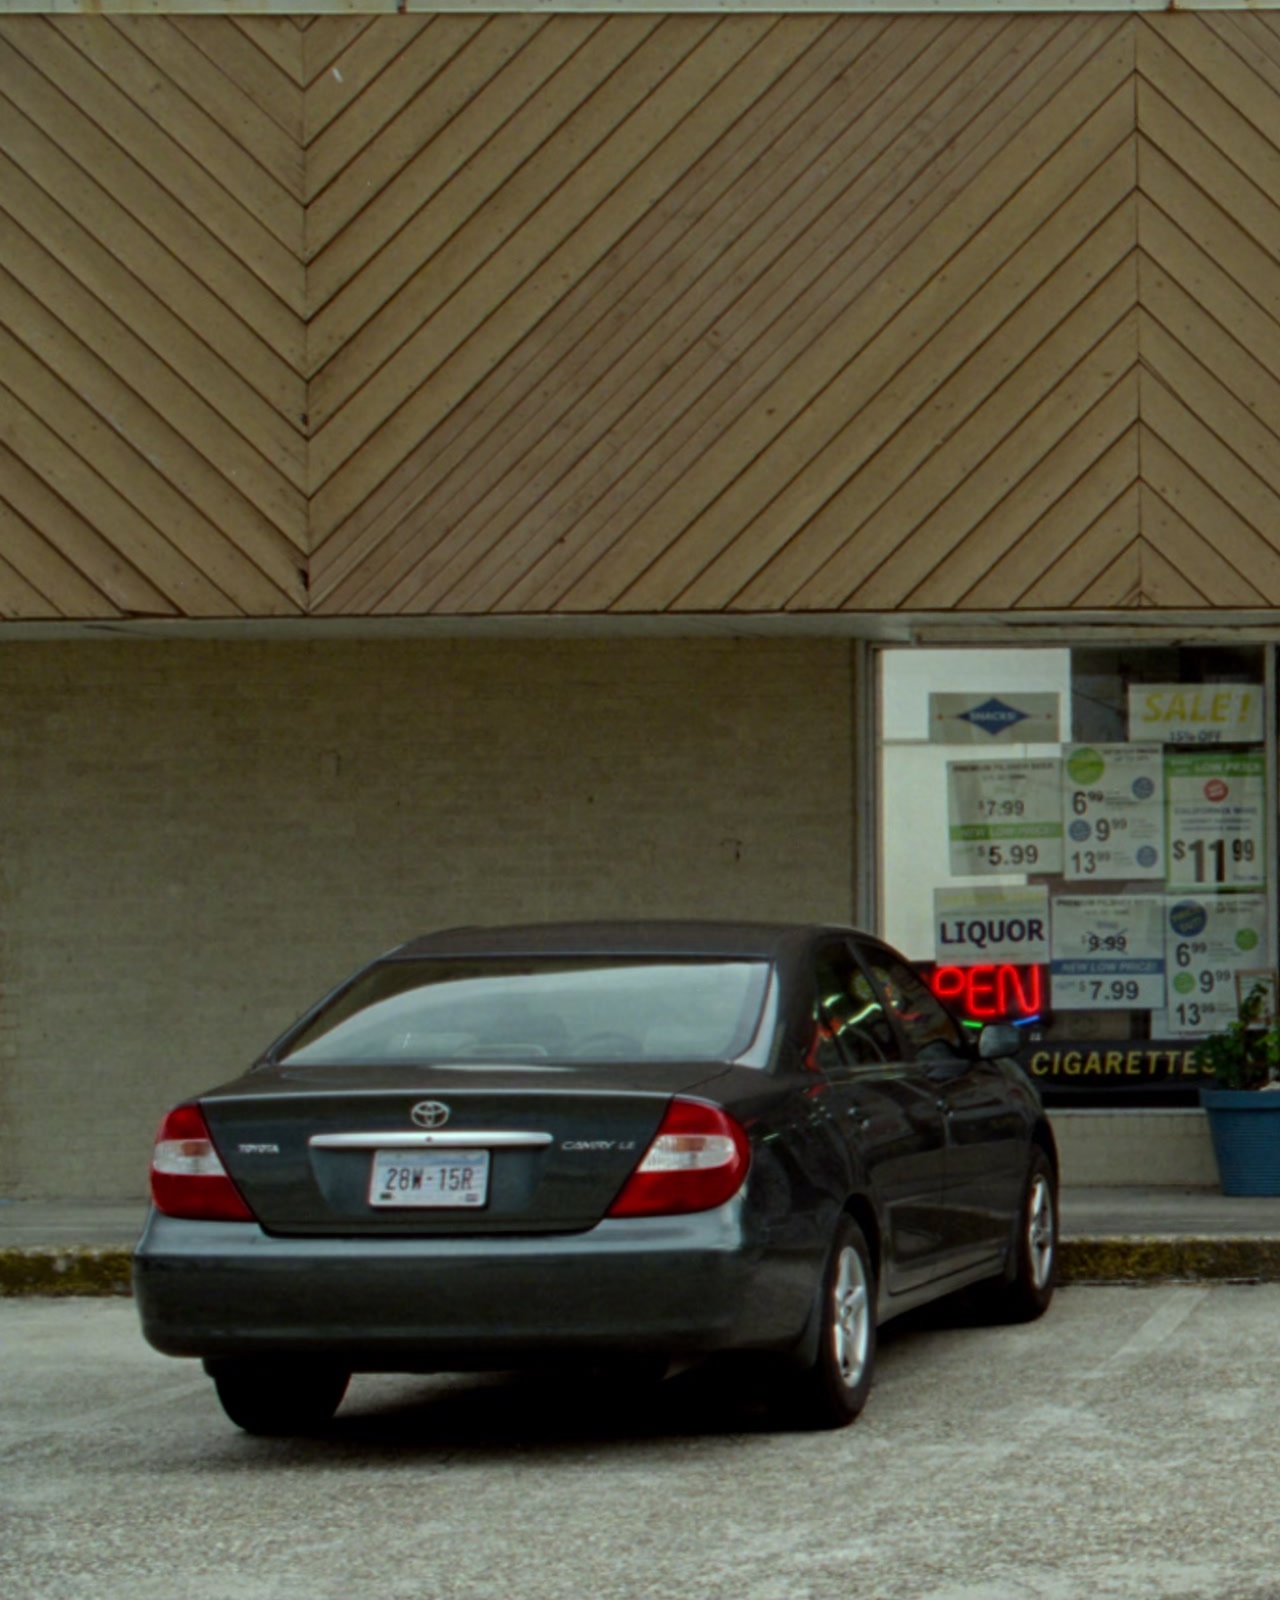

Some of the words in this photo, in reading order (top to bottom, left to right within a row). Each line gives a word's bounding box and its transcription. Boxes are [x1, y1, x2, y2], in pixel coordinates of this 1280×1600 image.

[940, 919, 1045, 948] LIQUOR
[930, 961, 1042, 1018] PEN
[238, 1143, 280, 1154] TOYOTA
[560, 1139, 616, 1150] CAMRY
[386, 1167, 474, 1191] 28W-15R
